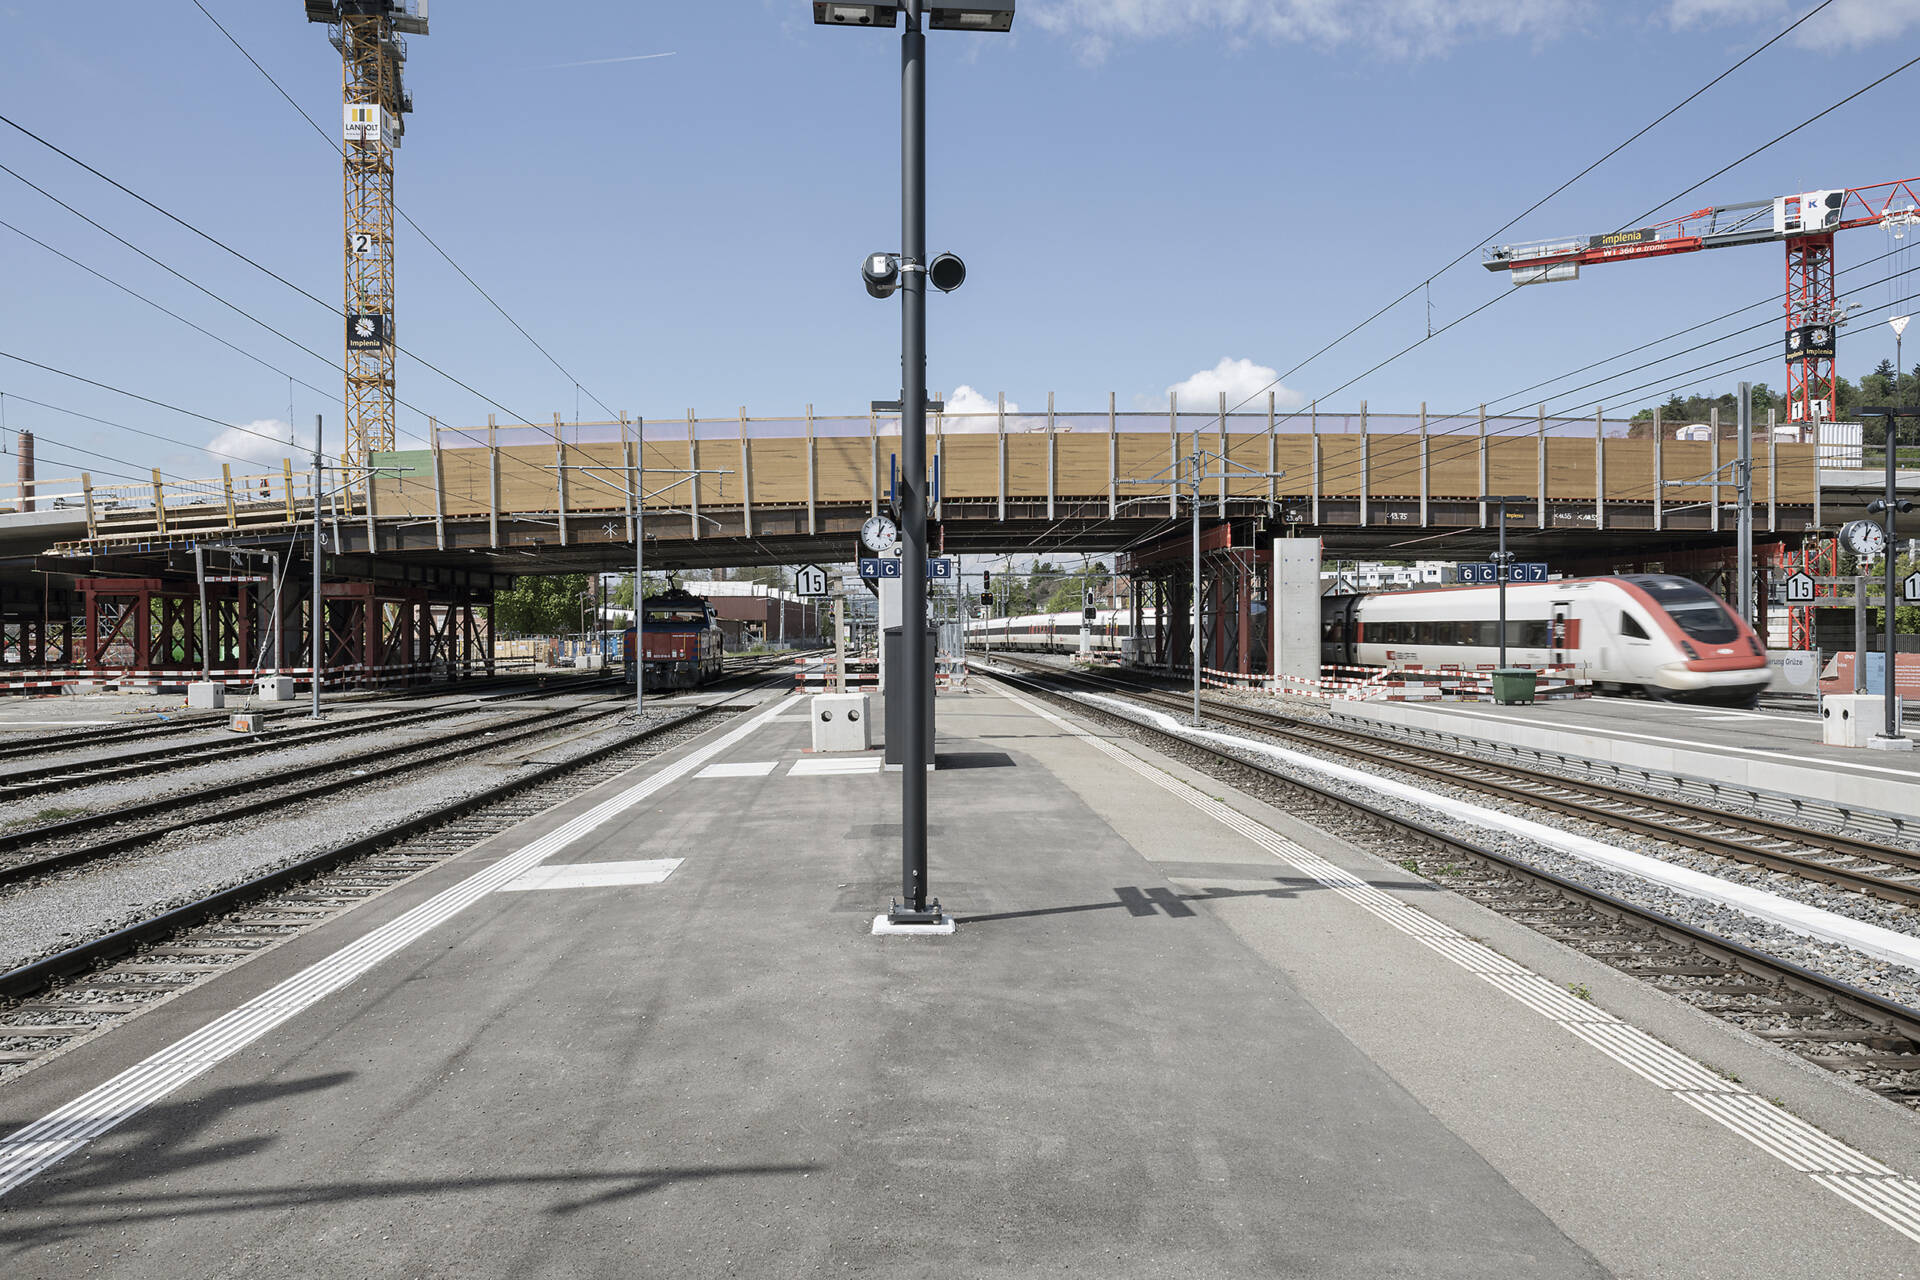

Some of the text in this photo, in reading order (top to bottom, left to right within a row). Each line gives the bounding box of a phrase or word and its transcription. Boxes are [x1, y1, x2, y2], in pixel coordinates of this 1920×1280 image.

[1602, 232, 1641, 245] implenia
[357, 236, 368, 252] 2
[1619, 247, 1634, 255] 360
[866, 565, 894, 575] 4 C
[937, 565, 945, 575] 5
[1464, 569, 1492, 579] 6 C
[1514, 569, 1542, 579] C 7
[803, 571, 821, 592] 15
[1792, 579, 1809, 598] 15
